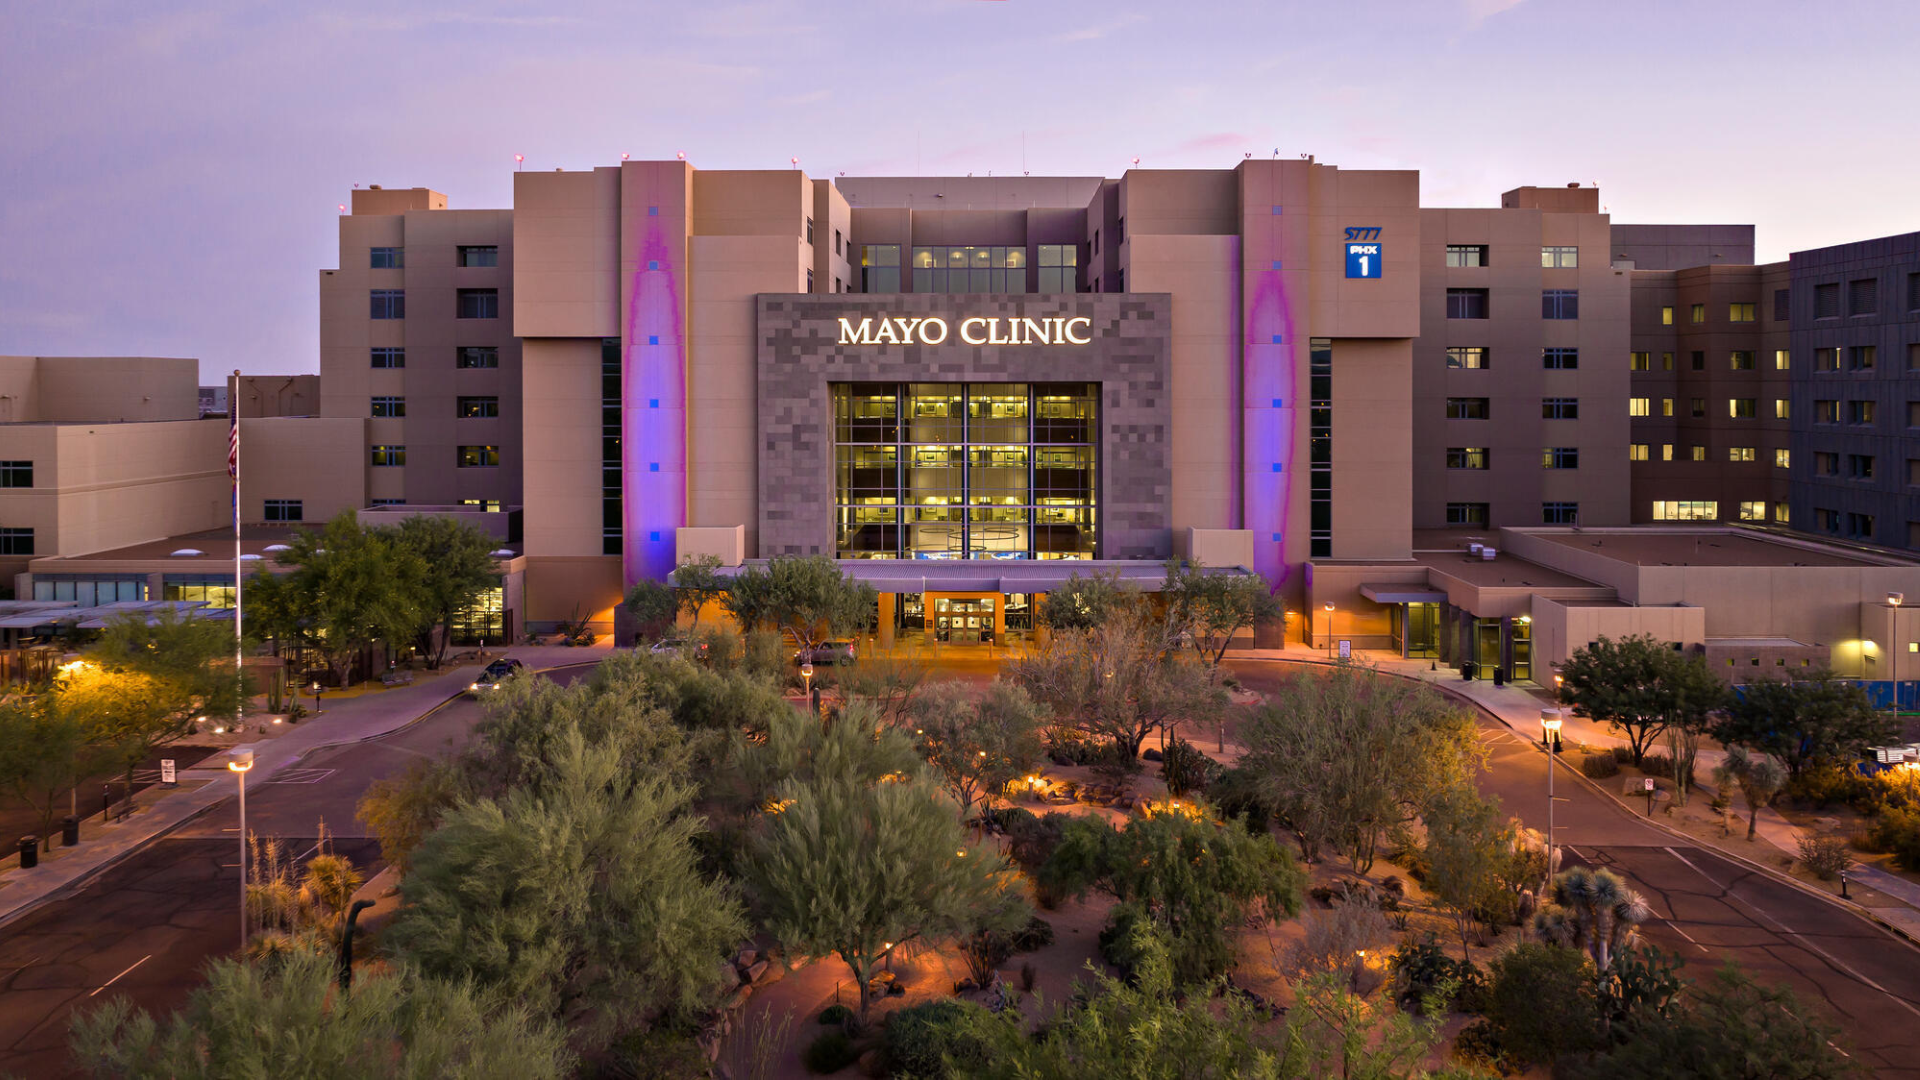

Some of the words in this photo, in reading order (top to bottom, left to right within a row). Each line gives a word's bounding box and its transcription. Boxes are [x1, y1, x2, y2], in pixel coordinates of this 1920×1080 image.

[1345, 227, 1382, 240] 5777
[1350, 246, 1377, 254] PHX
[1359, 256, 1368, 276] 1
[838, 317, 948, 345] MAYO
[960, 317, 1092, 345] CLINIC
